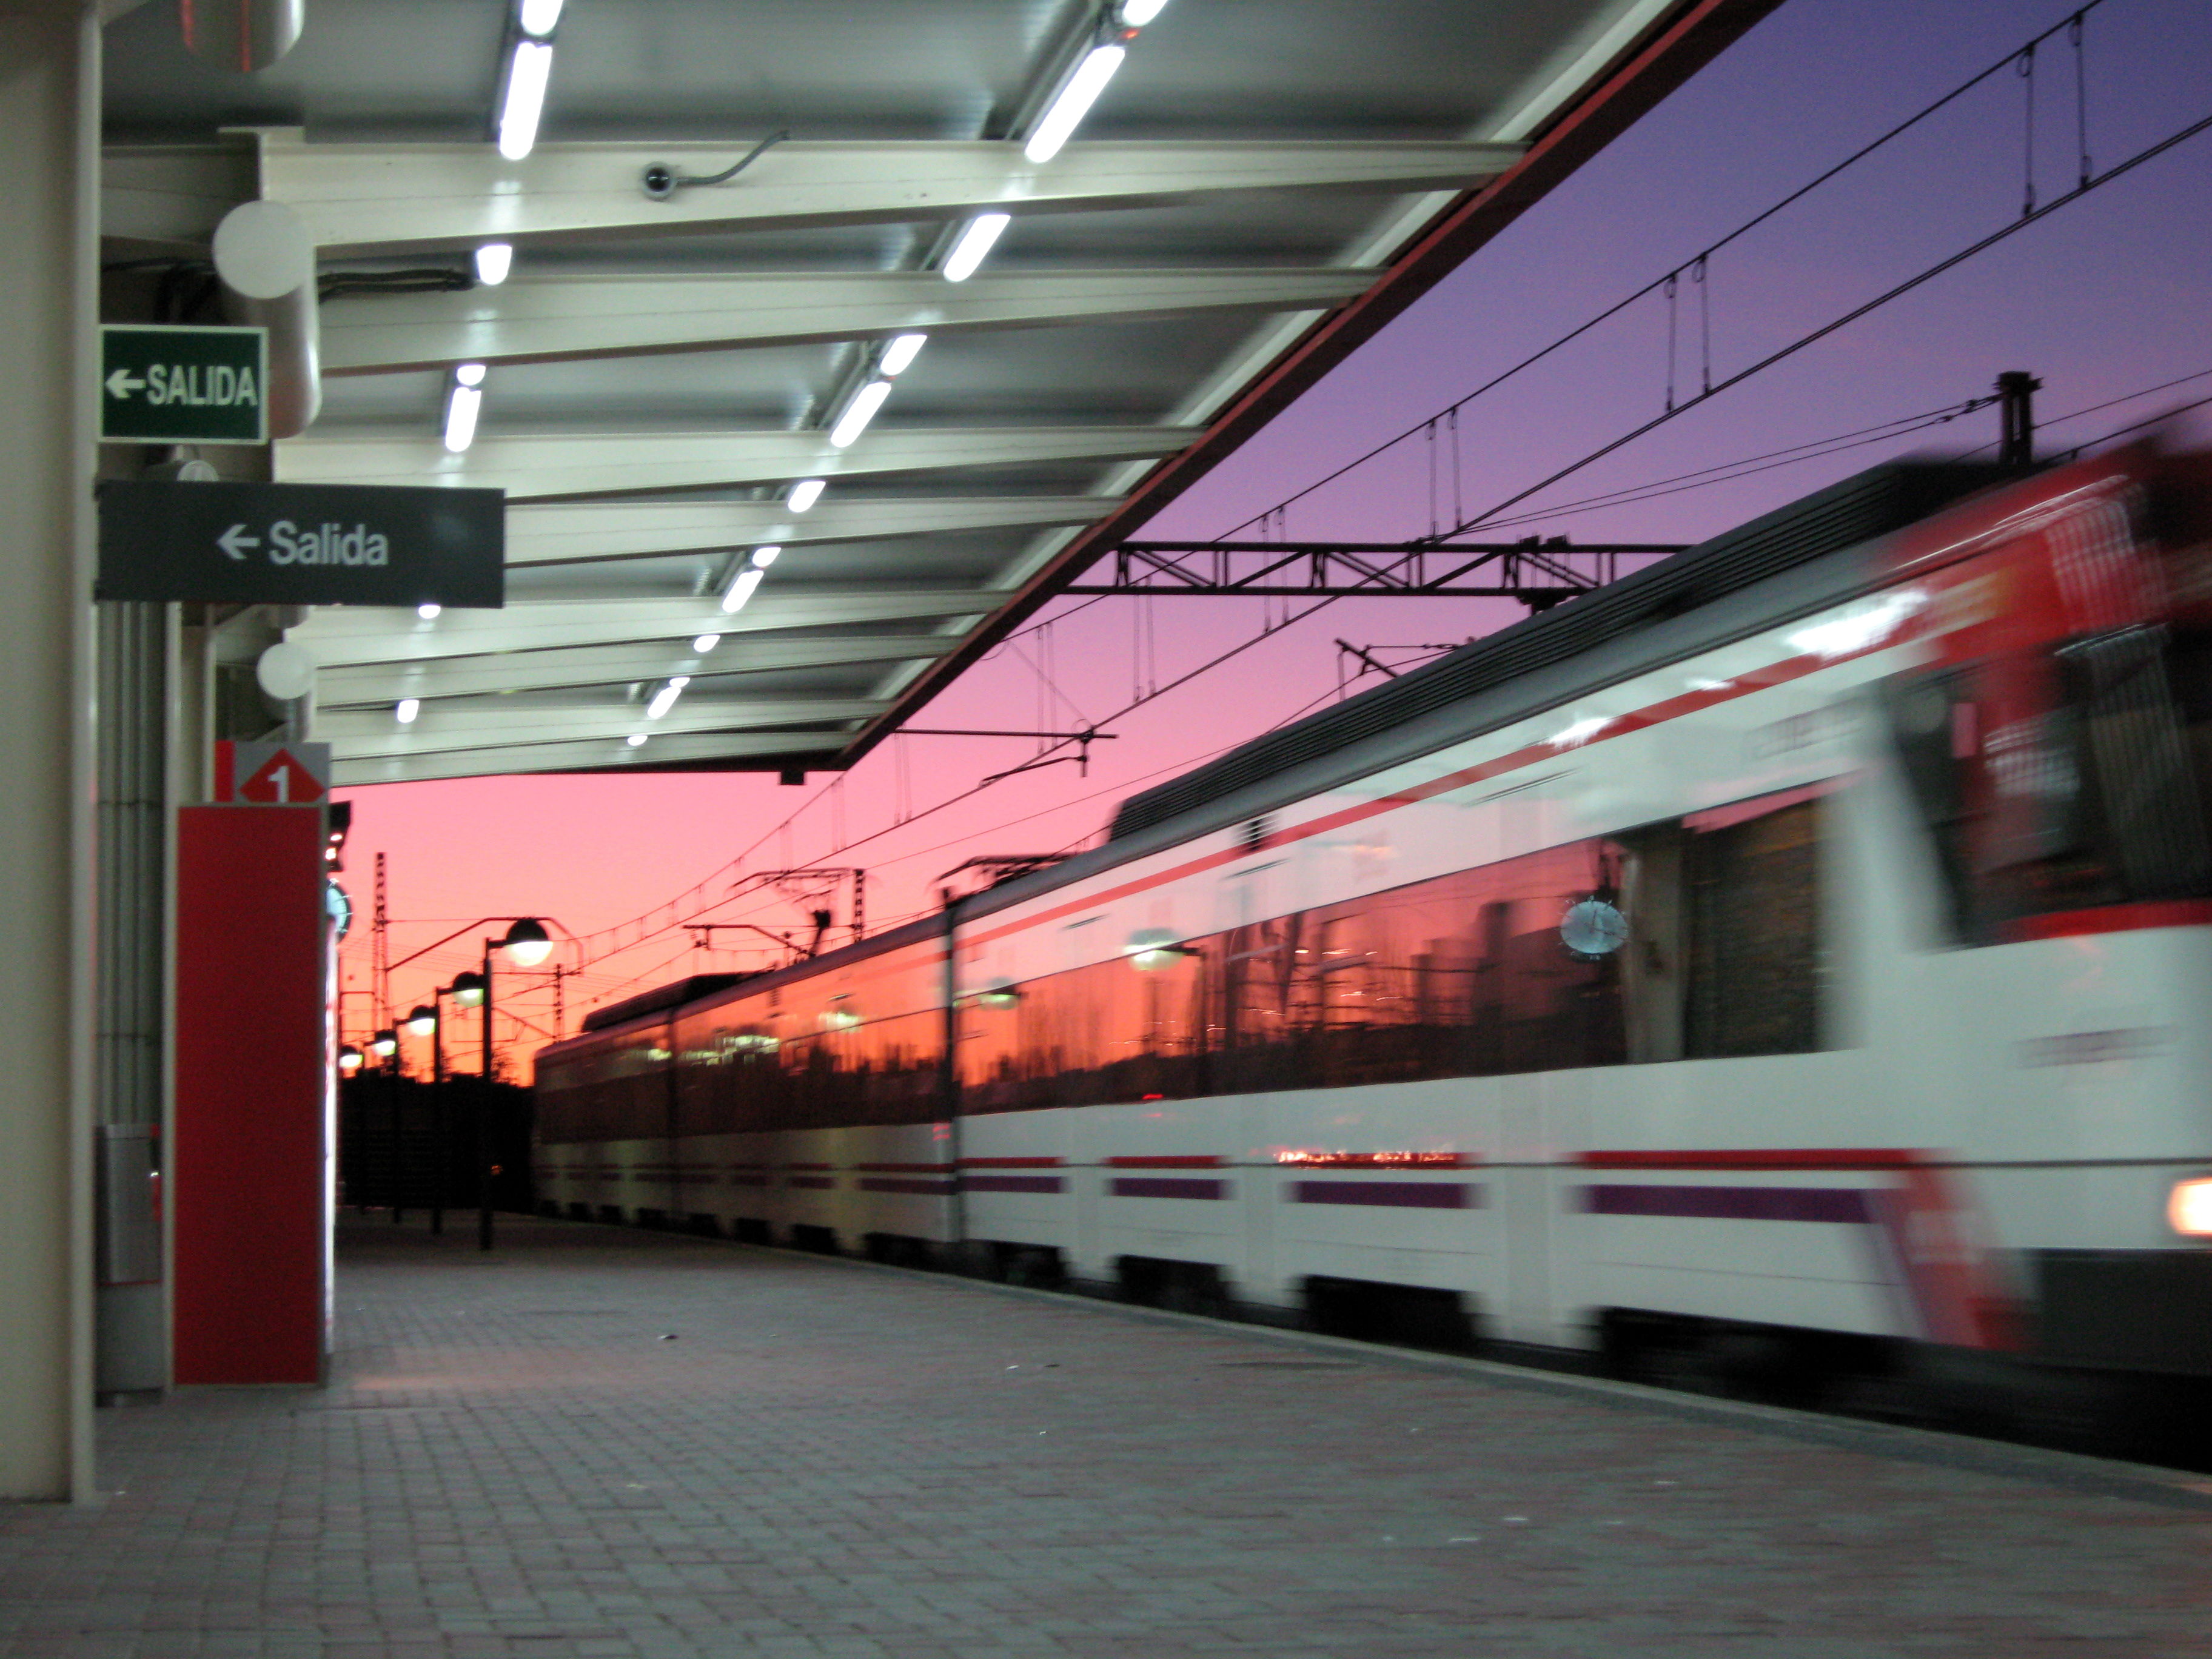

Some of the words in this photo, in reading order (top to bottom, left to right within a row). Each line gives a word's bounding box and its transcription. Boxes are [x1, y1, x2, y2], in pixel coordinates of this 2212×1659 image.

[147, 364, 258, 406] SALIDA
[269, 520, 389, 566] Salida
[267, 765, 290, 803] 1
